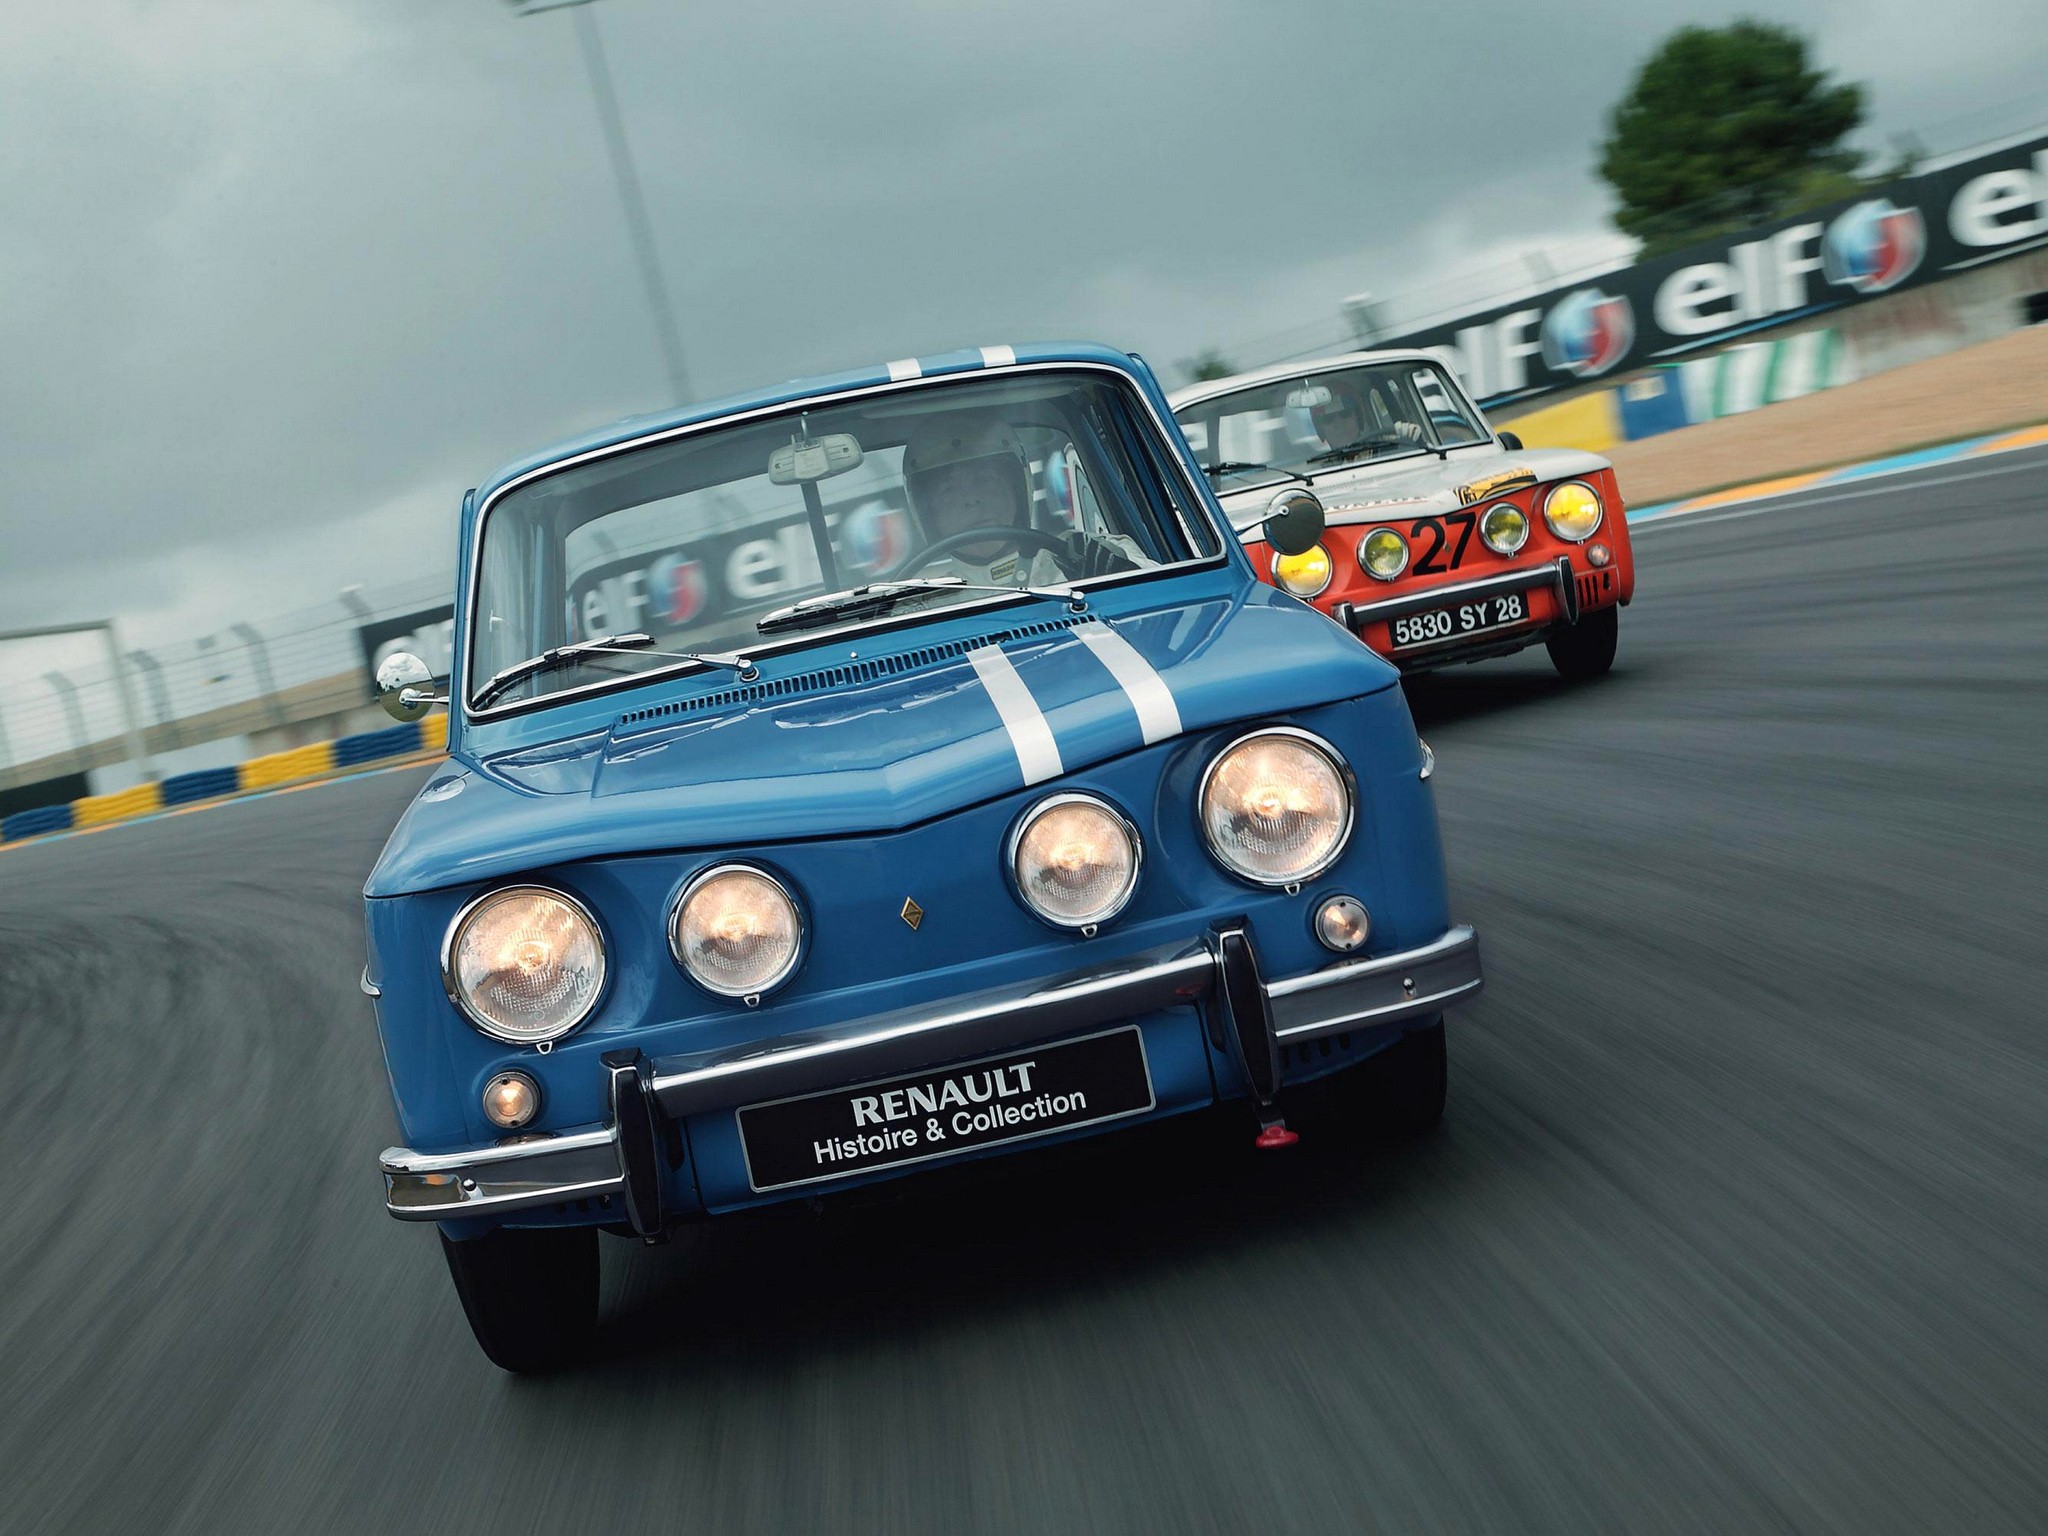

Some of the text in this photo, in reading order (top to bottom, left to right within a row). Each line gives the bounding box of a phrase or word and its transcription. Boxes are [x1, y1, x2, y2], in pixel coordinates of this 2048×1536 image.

[1654, 221, 1824, 336] elf
[1411, 512, 1477, 576] 27
[1396, 595, 1522, 643] 5830 SY 28
[850, 1061, 1036, 1127] RENAULT
[813, 1091, 1087, 1164] Histoire & Collection
